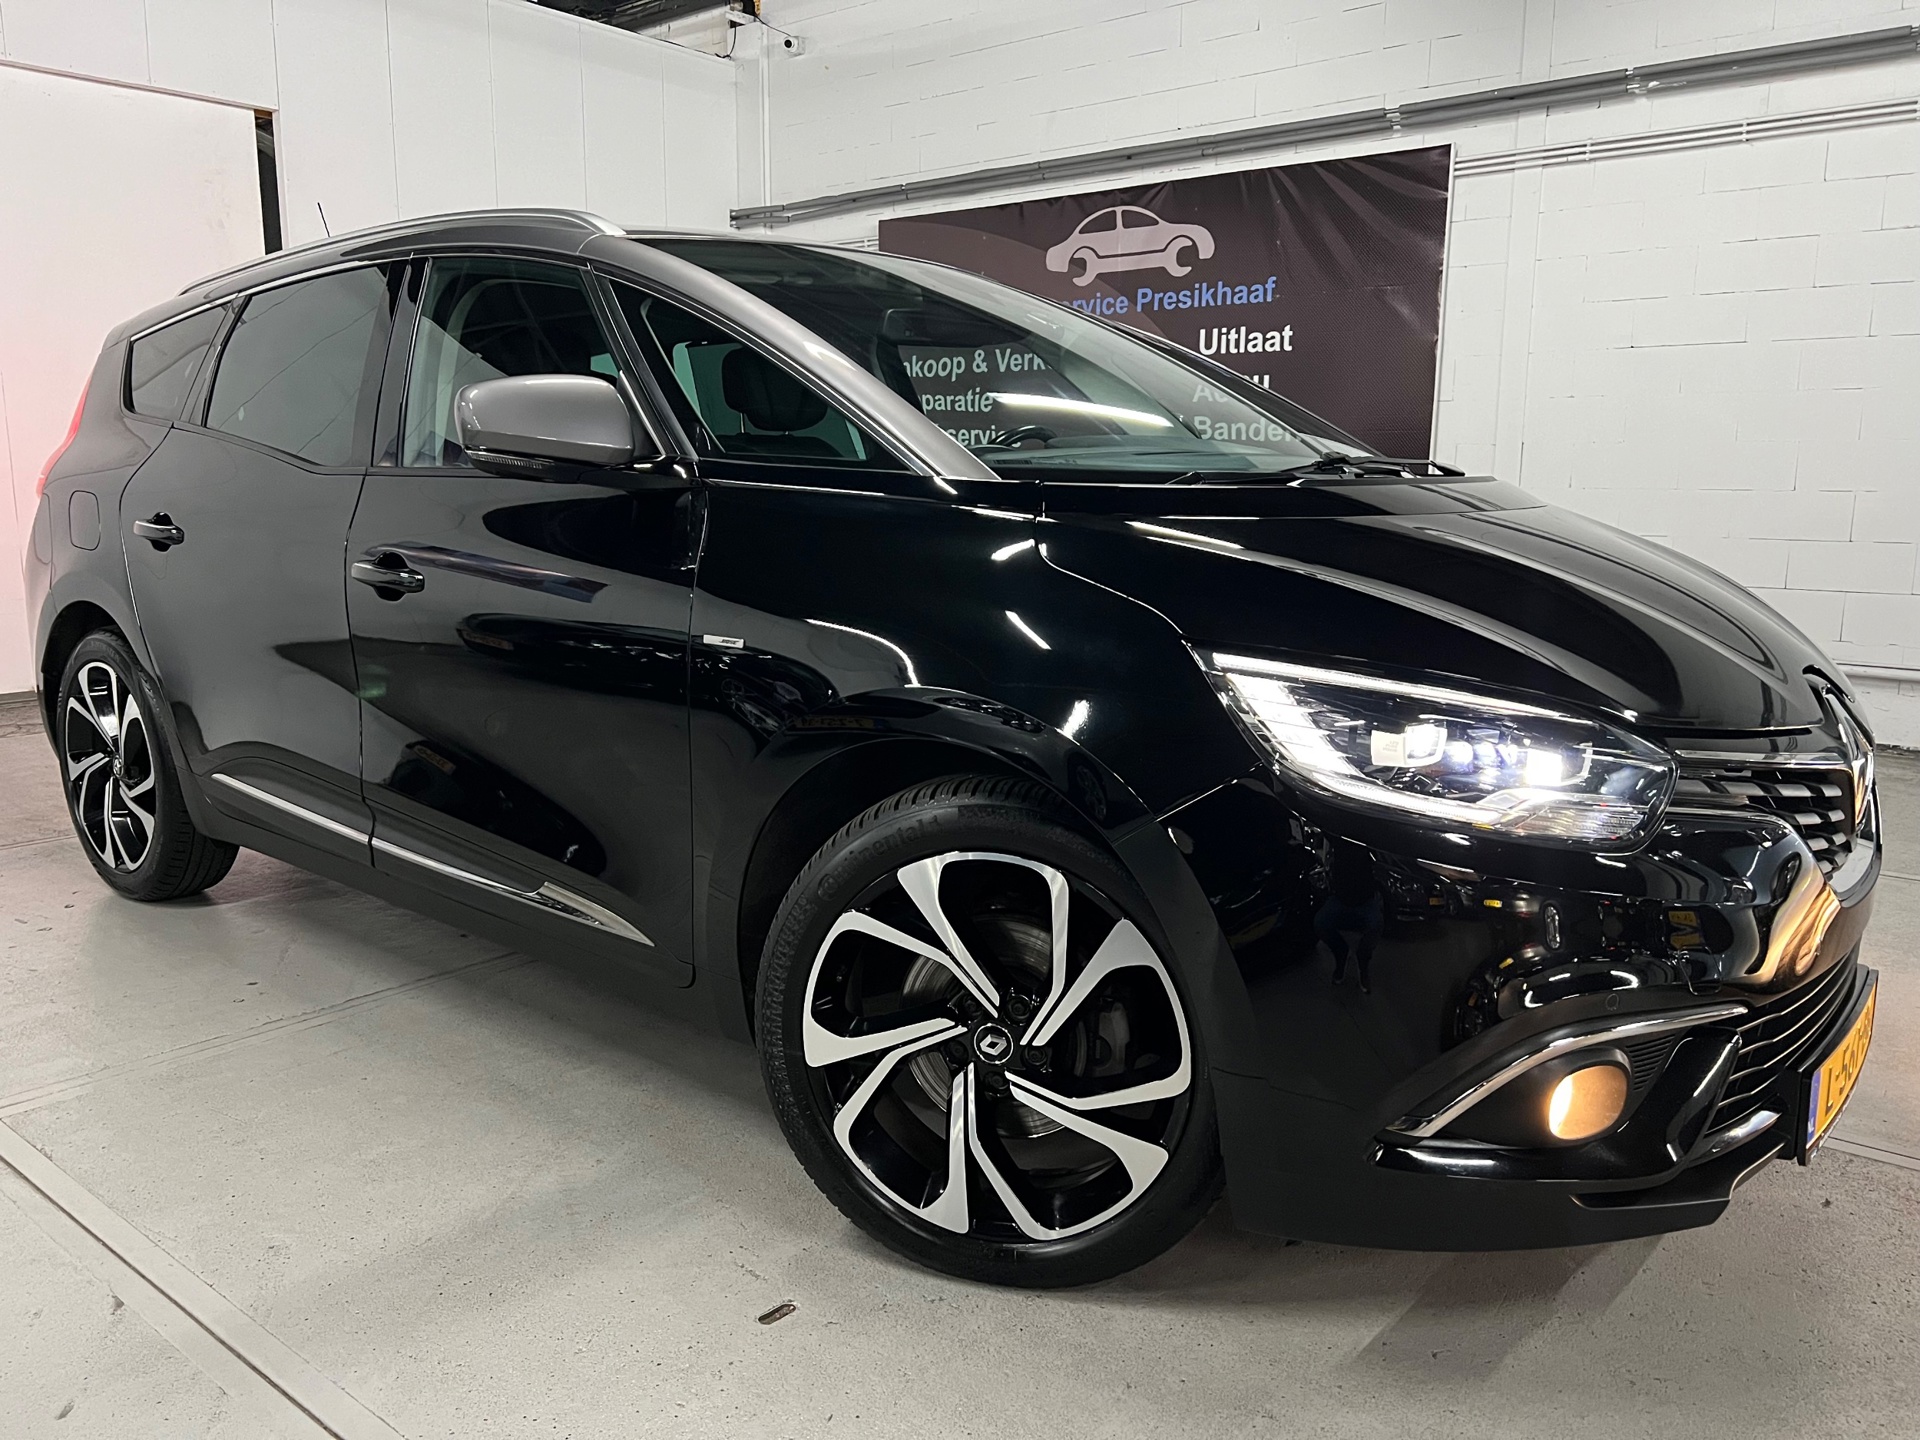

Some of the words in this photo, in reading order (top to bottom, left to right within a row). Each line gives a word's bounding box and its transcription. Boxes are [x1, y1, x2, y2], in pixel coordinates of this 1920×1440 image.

[1136, 276, 1277, 312] Presikhaaf
[1199, 325, 1294, 355] Uitlaat
[903, 355, 966, 382] nkoop
[972, 350, 989, 373] &
[995, 348, 1053, 373] Verk
[918, 386, 993, 415] paratie
